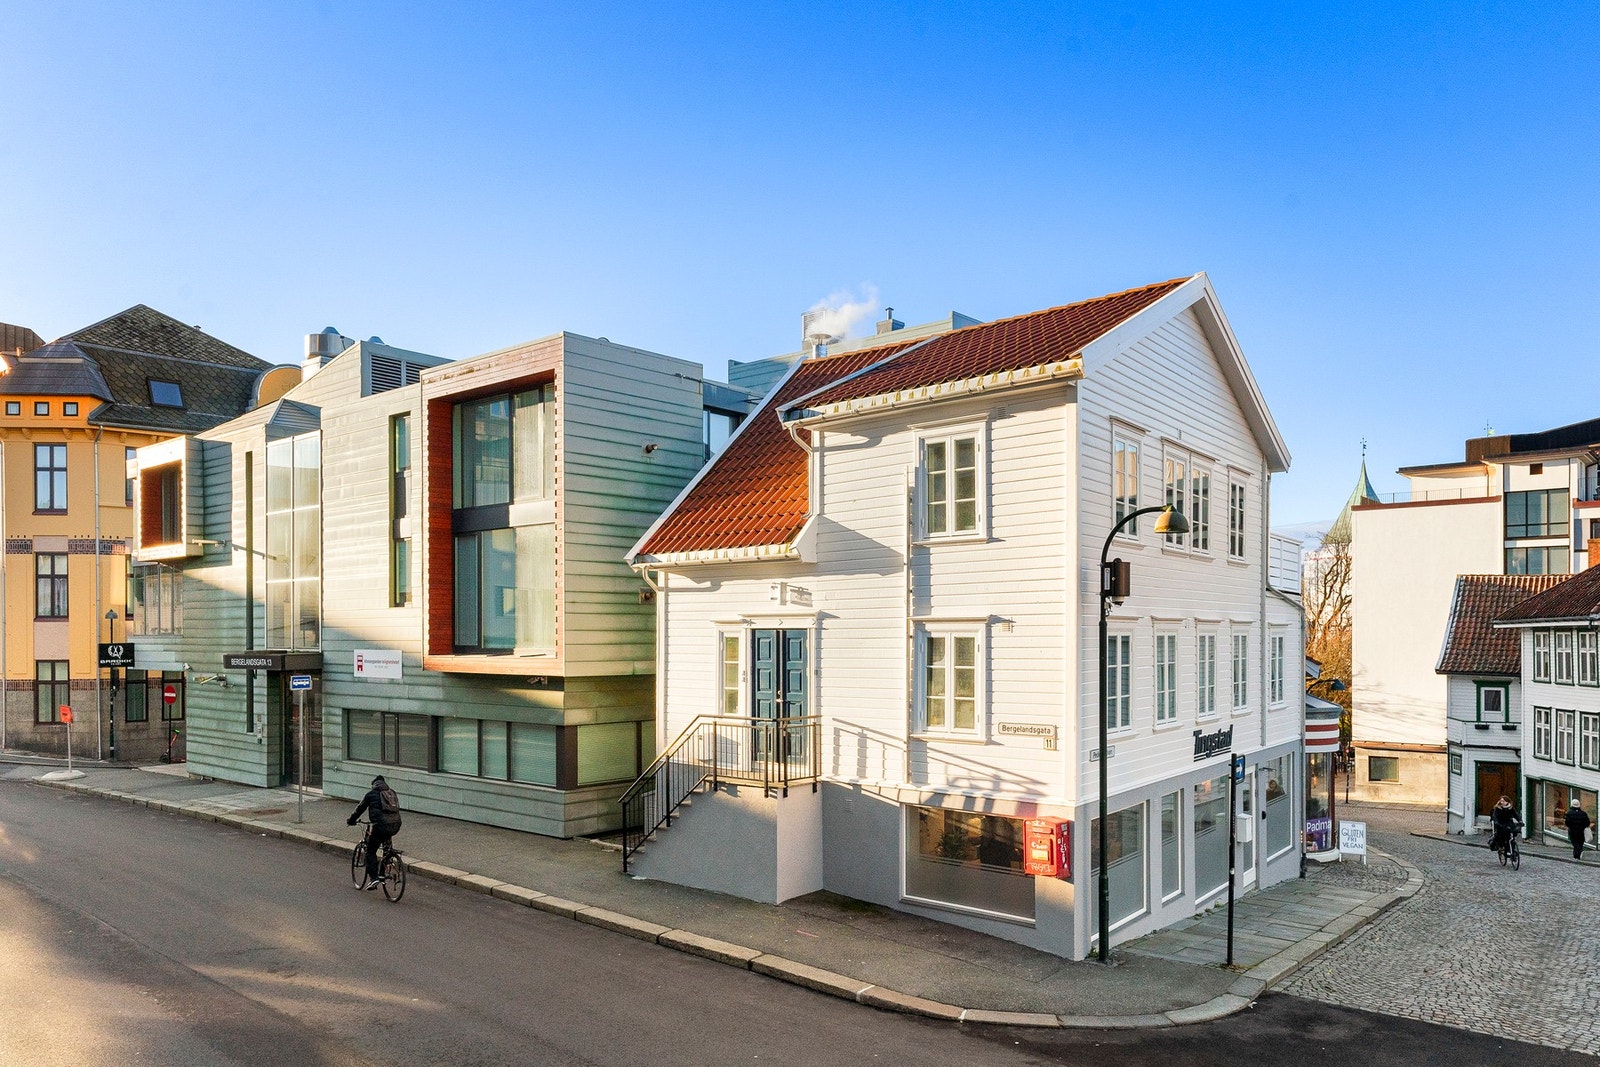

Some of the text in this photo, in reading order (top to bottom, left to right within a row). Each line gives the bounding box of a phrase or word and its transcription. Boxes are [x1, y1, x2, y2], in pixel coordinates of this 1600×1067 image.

[231, 658, 266, 666] BERGELANDSGATA
[1001, 724, 1051, 735] Bergelandsgata
[1045, 739, 1052, 748] 11
[1193, 724, 1233, 758] Tingstad
[1306, 820, 1332, 833] Padma
[1341, 828, 1364, 839] GLUTEN
[1342, 842, 1364, 850] VEGAN
